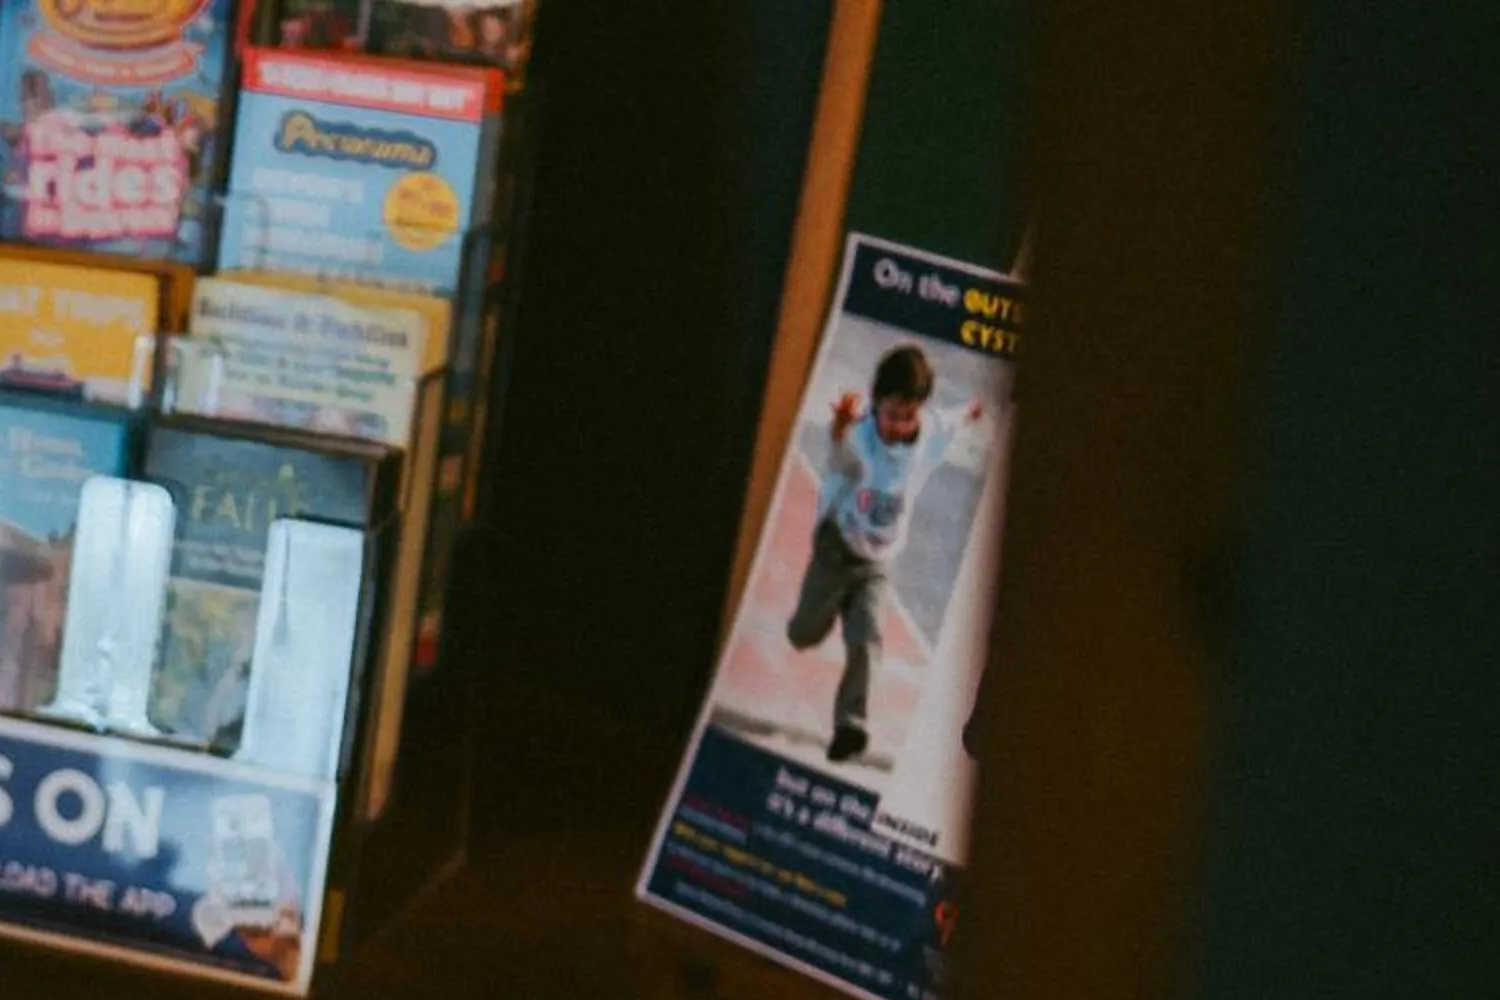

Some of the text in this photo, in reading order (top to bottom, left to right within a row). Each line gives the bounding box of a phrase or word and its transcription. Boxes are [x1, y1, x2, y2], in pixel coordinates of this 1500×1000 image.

[873, 257, 913, 295] On
[918, 273, 961, 308] the
[33, 767, 166, 860] ON
[64, 871, 118, 911] THE
[119, 885, 180, 920] APP
